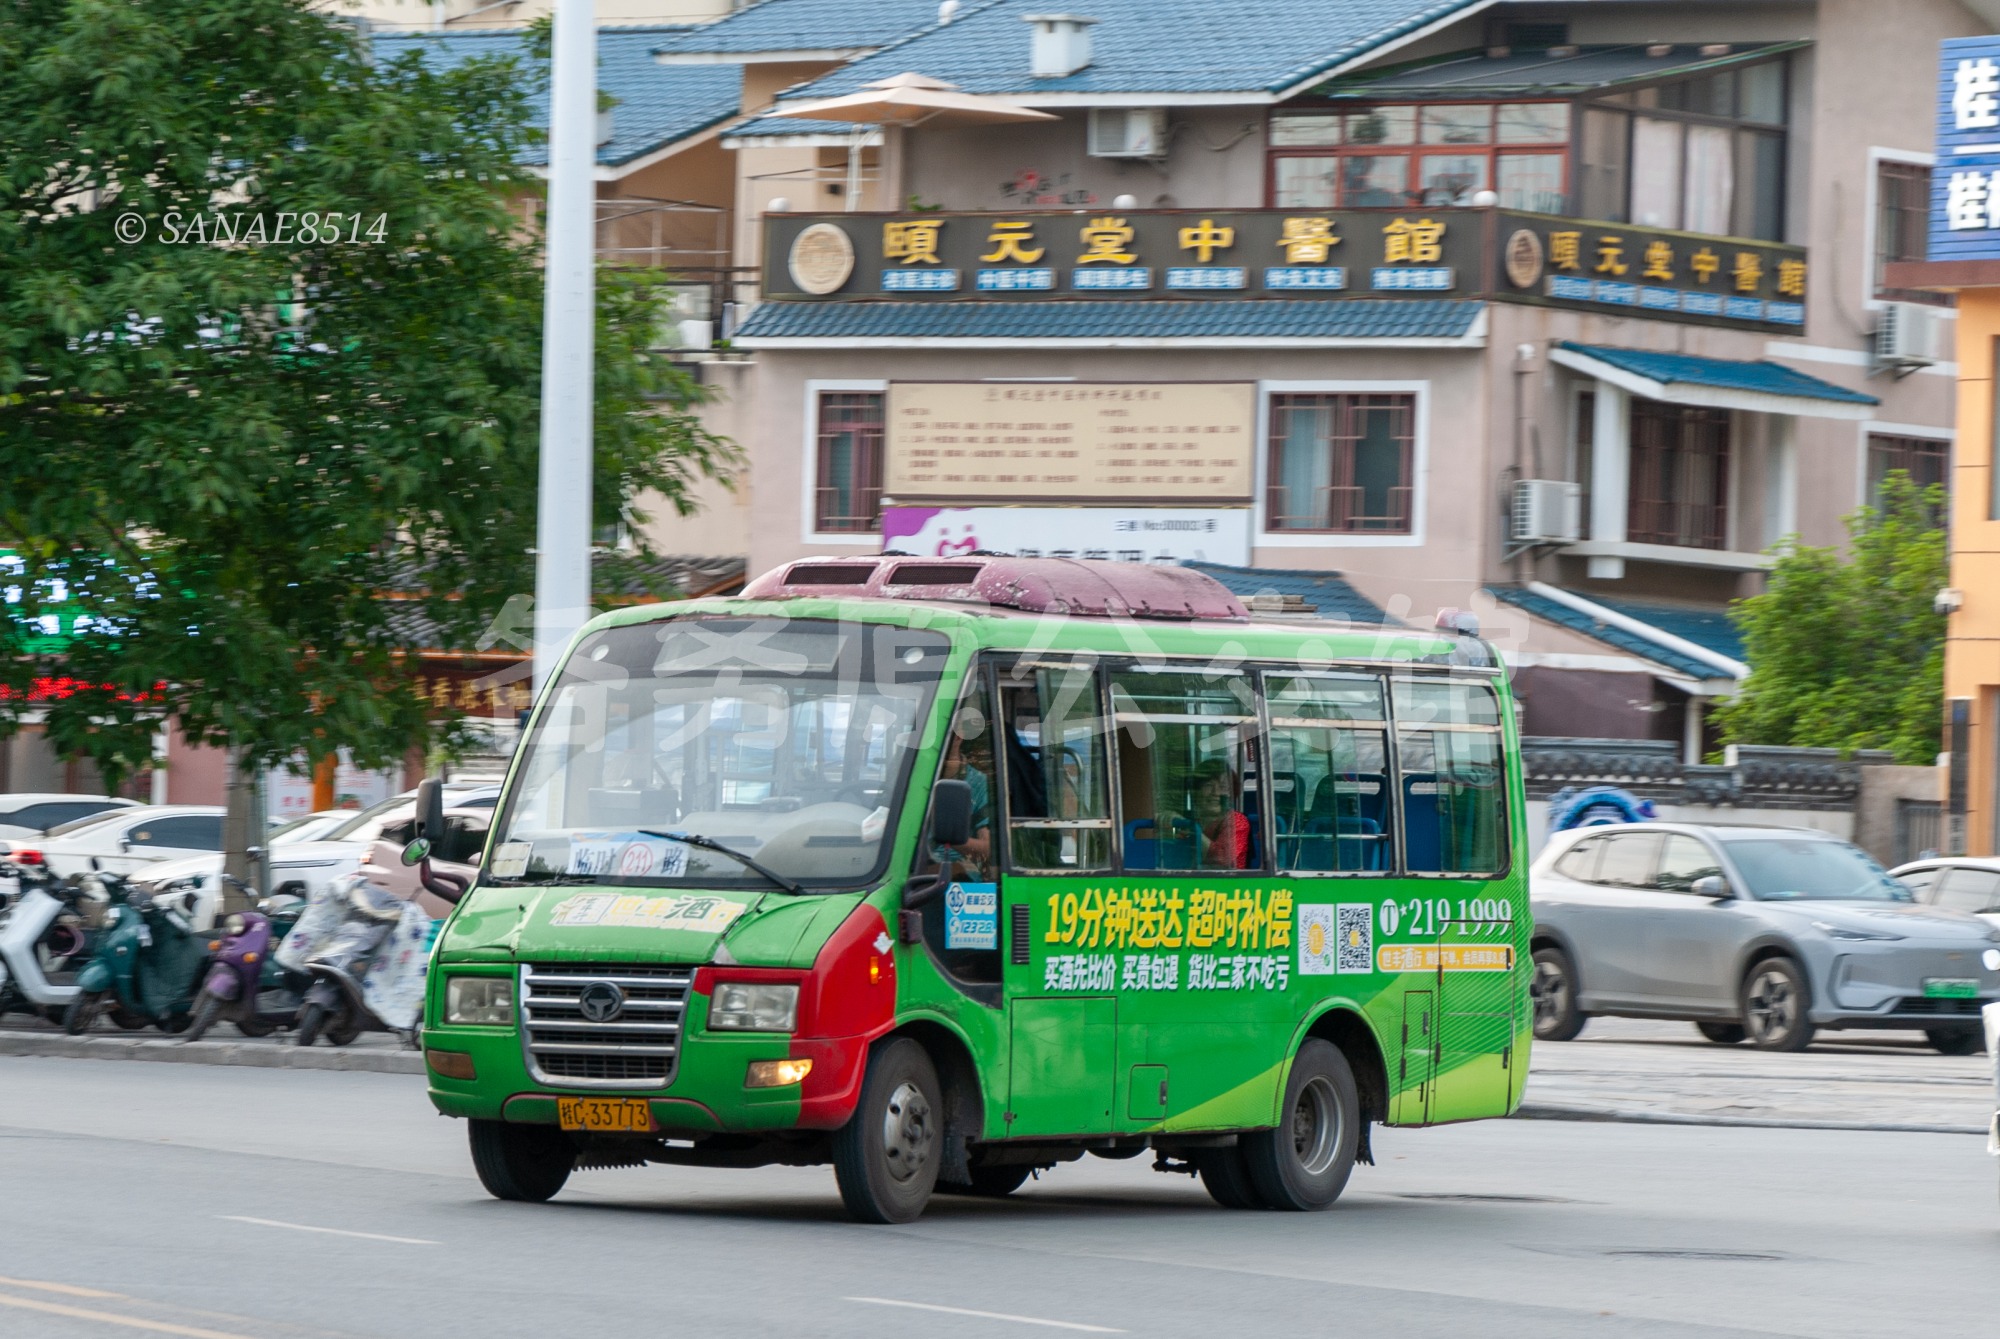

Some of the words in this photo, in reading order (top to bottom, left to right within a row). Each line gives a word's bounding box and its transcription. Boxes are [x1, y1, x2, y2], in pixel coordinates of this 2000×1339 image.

[625, 850, 649, 873] 211
[661, 847, 684, 875] 路
[1044, 888, 1185, 950] 19分钟送达
[1186, 888, 1293, 950] 超时补偿
[1409, 898, 1452, 936] 219
[1457, 898, 1513, 936] 1999
[1044, 954, 1117, 991] 买酒先比价
[1121, 954, 1179, 991] 买贵包退
[1187, 954, 1290, 991] 货比三家不吃亏
